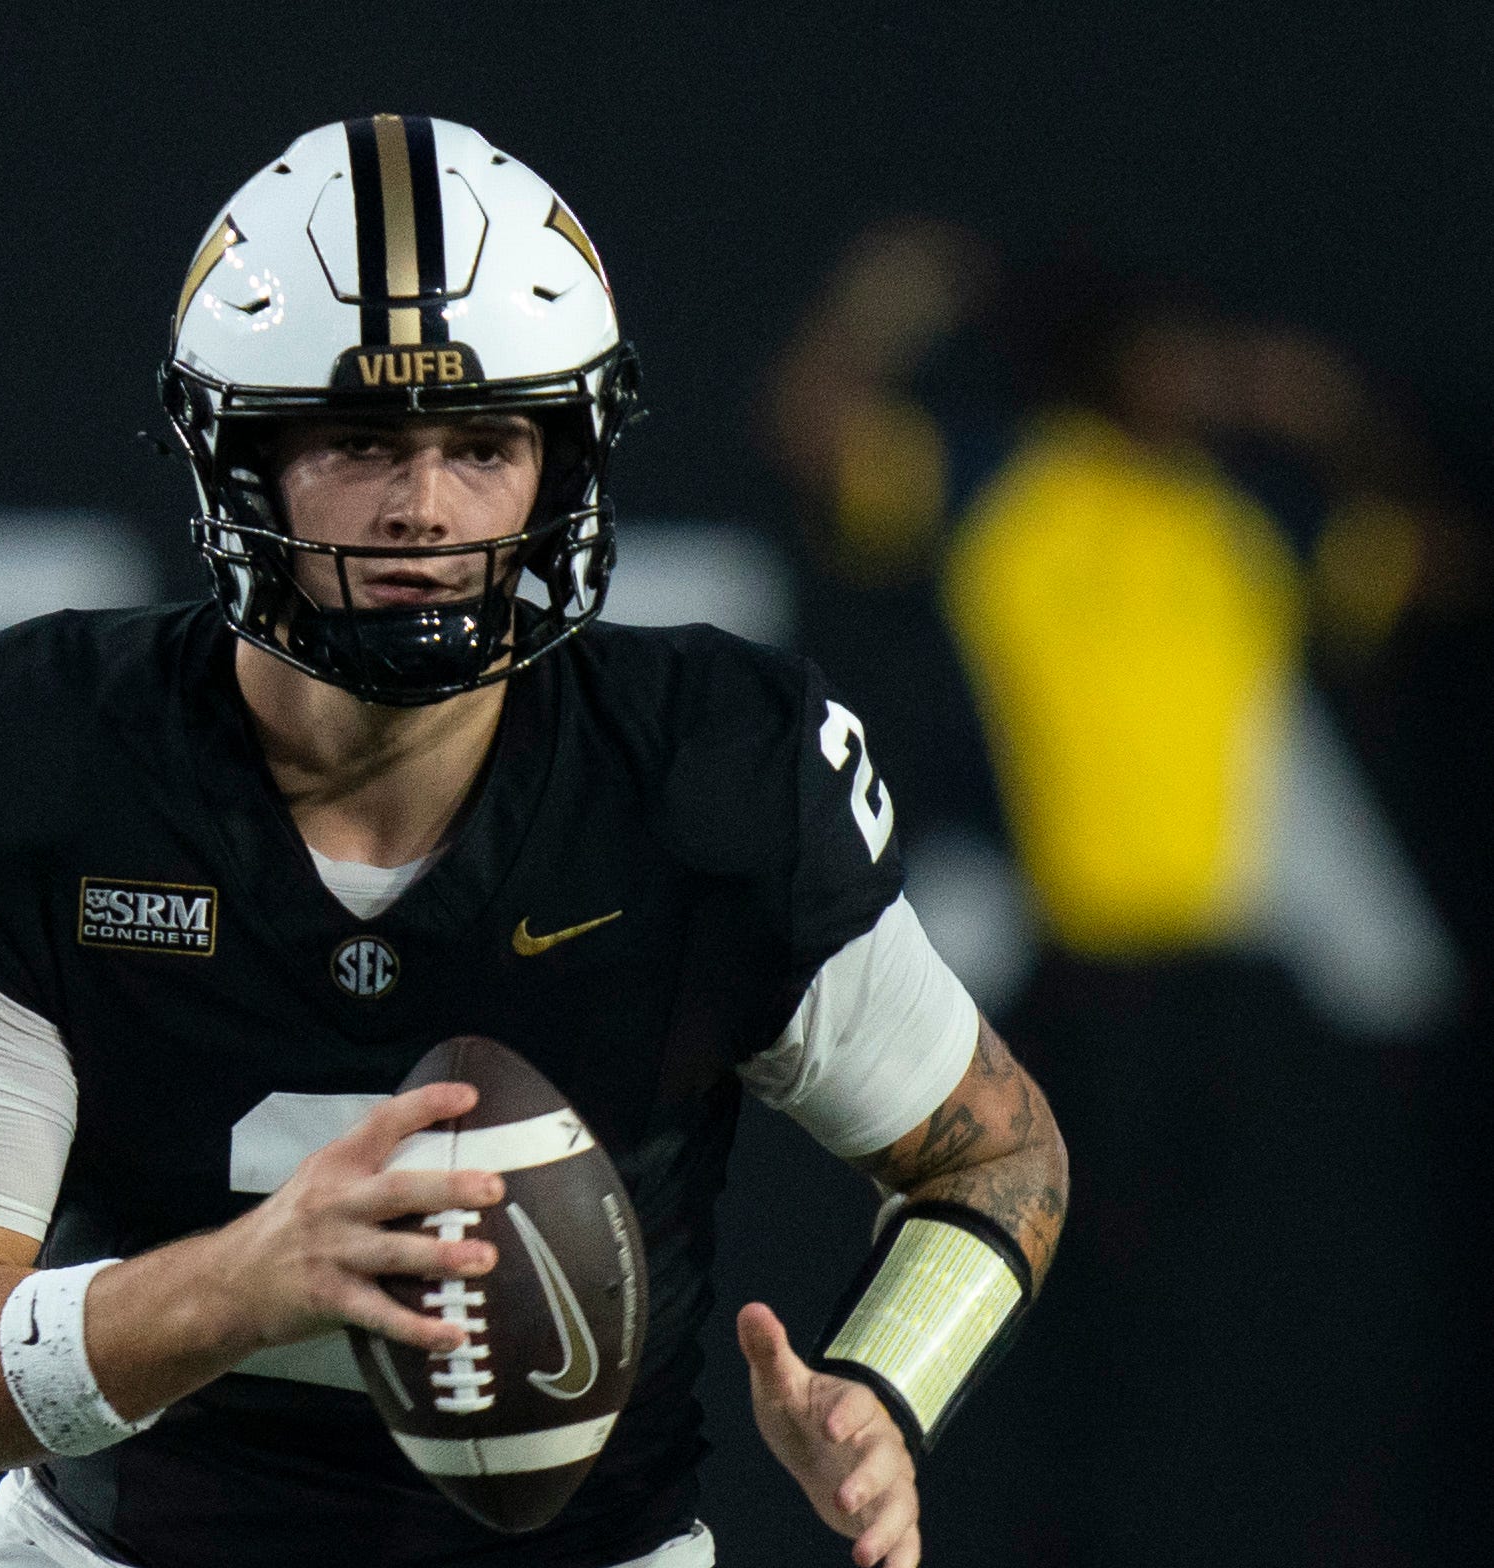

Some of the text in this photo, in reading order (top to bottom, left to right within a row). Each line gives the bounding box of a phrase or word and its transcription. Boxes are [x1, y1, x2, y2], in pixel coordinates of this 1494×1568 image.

[358, 350, 464, 386] VUFB
[819, 699, 894, 864] 2
[107, 889, 212, 932] SRM
[83, 924, 210, 947] CONCRETE
[338, 941, 393, 995] SEC
